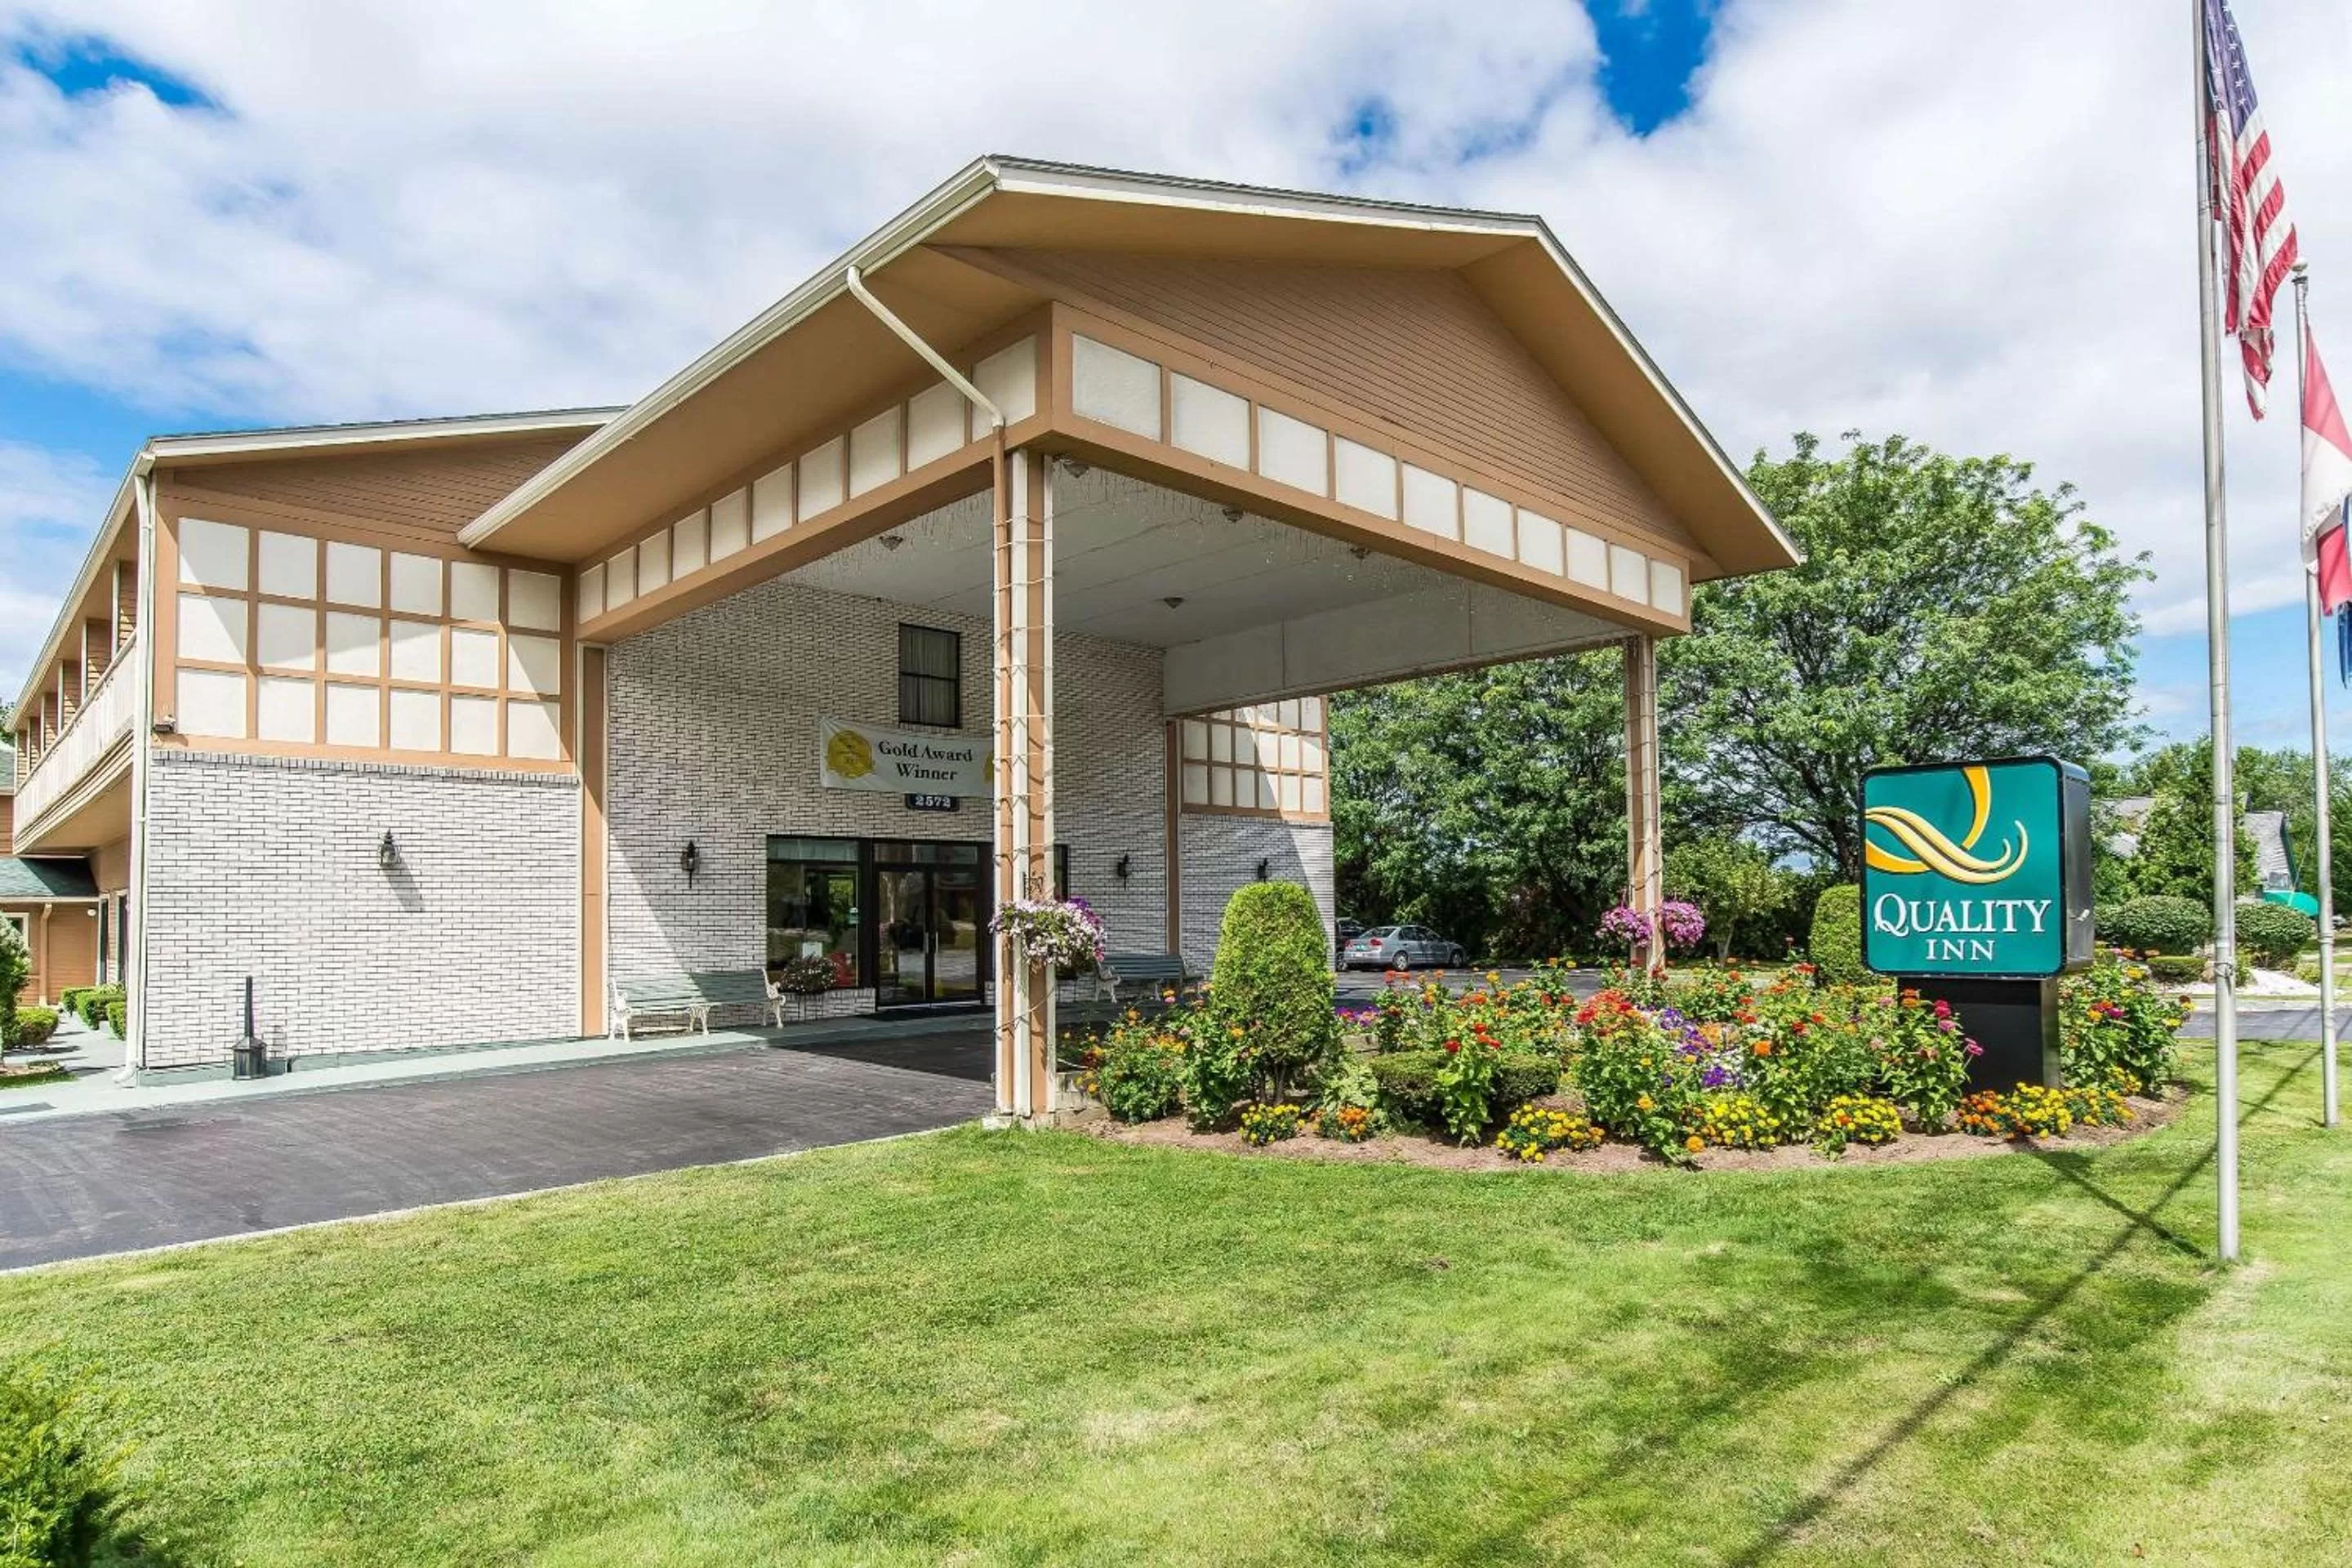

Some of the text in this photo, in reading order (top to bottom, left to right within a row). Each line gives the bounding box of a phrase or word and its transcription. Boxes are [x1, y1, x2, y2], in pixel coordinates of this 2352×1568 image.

[879, 741, 973, 762] Gold Award
[896, 762, 958, 781] Winner
[915, 795, 951, 808] 2572
[1873, 893, 2051, 937] QUALITY
[1926, 939, 1995, 961] INN
